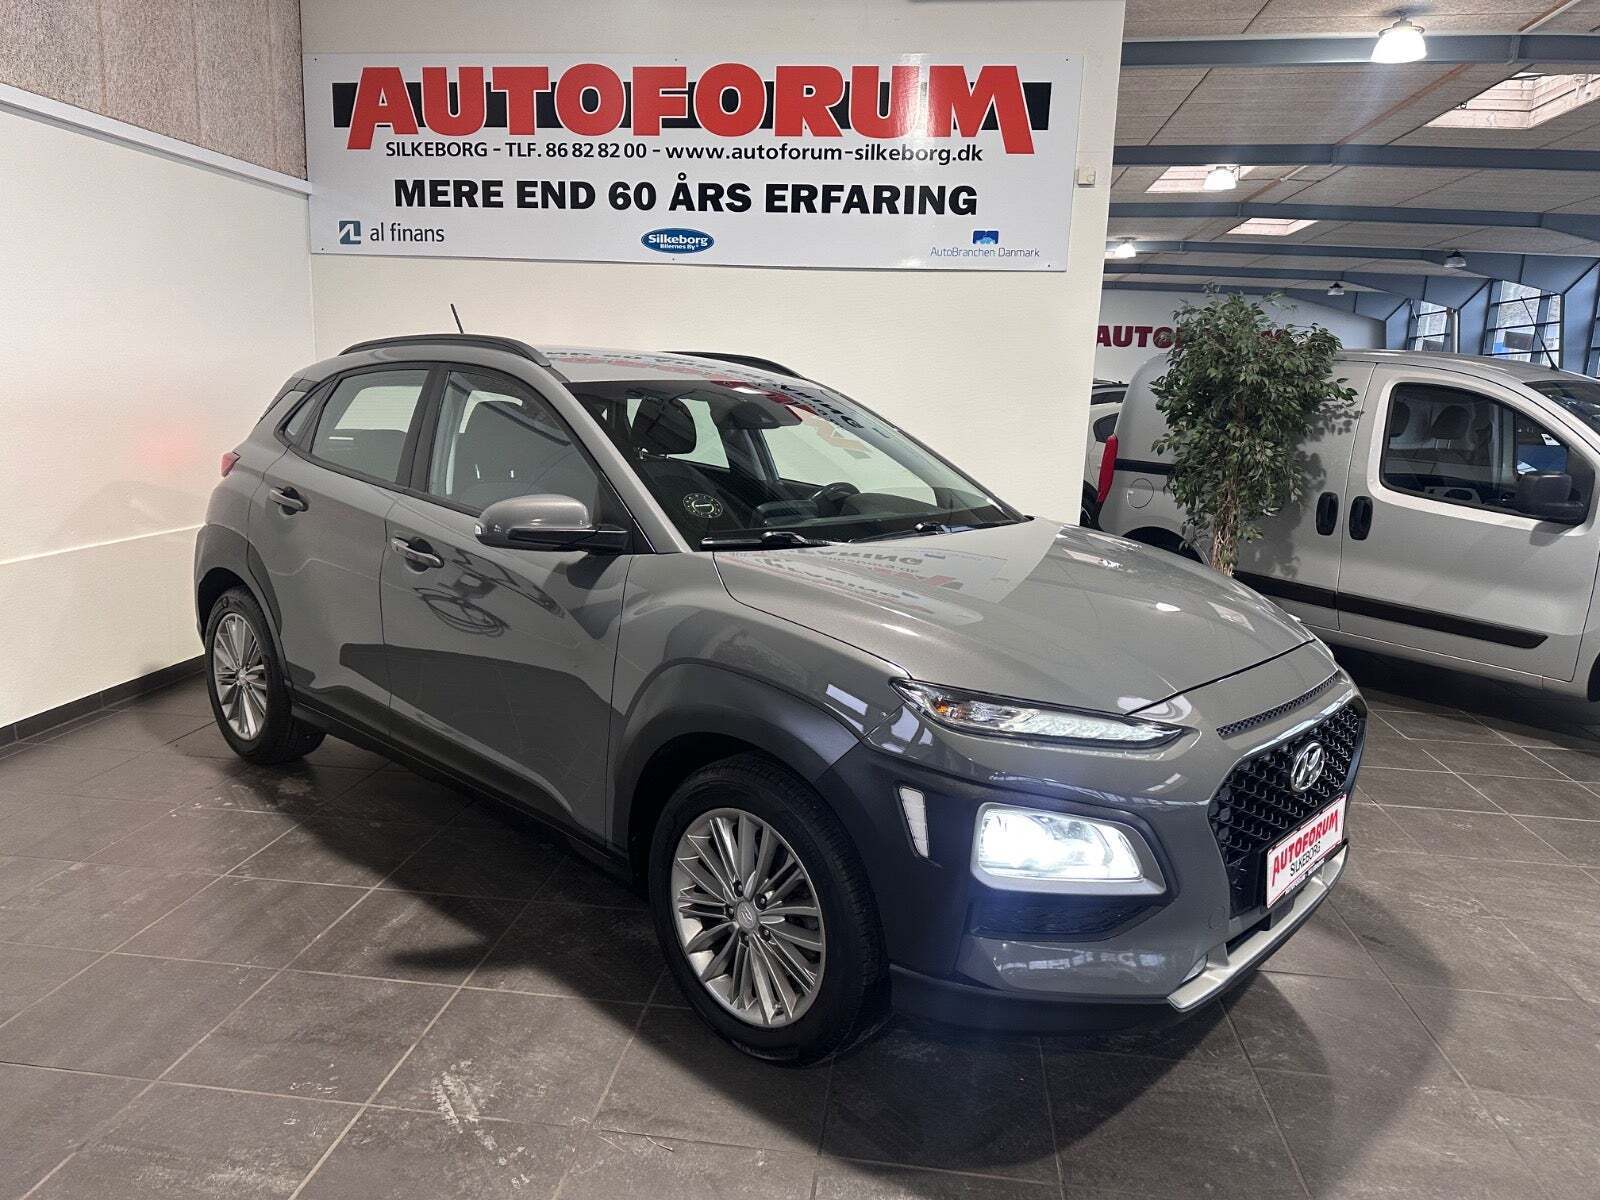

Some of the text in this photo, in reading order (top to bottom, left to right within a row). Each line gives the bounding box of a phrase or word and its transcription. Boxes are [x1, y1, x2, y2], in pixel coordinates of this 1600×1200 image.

[347, 63, 1035, 154] AUTOFORUM
[385, 141, 488, 157] SILKEBORG
[504, 143, 542, 157] TLF.
[665, 143, 984, 165] www.autoforum-silkeborg.dk
[394, 172, 978, 215] MERE END 60 ÅRS ERFARING
[370, 222, 445, 242] al finans
[648, 234, 709, 247] Silkeborg
[930, 247, 1040, 257] AutoBranchen Danmark
[1271, 809, 1338, 887] AUTOFORUM
[1290, 841, 1321, 876] SILKEBORG
